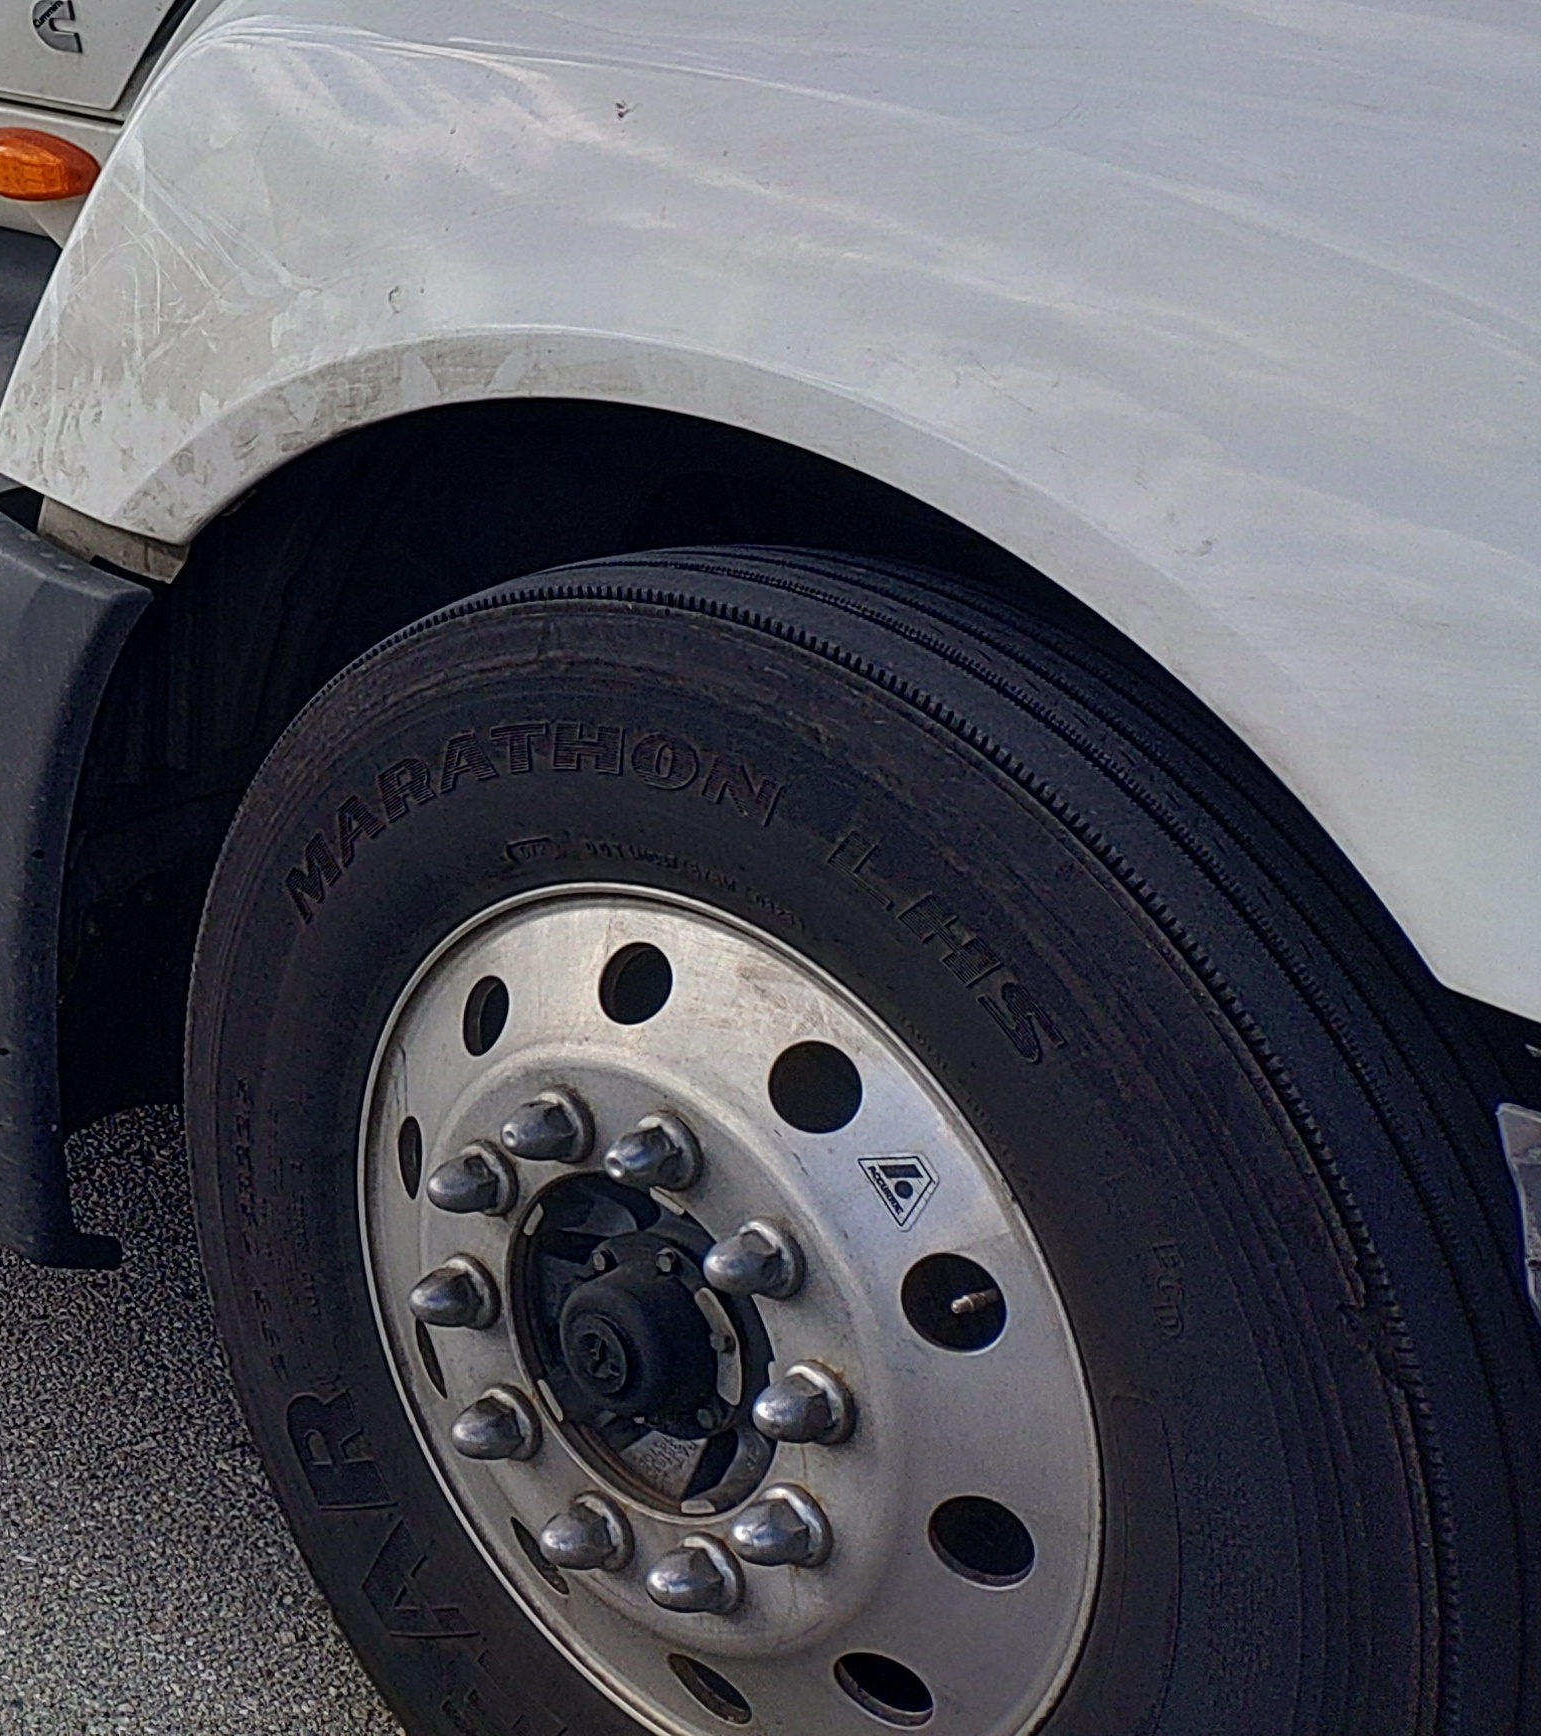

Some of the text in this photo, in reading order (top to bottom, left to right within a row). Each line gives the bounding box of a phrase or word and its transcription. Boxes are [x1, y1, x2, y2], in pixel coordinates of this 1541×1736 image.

[284, 721, 1068, 1063] MARATHON LHS
[868, 1166, 904, 1215] ACCURIDE
